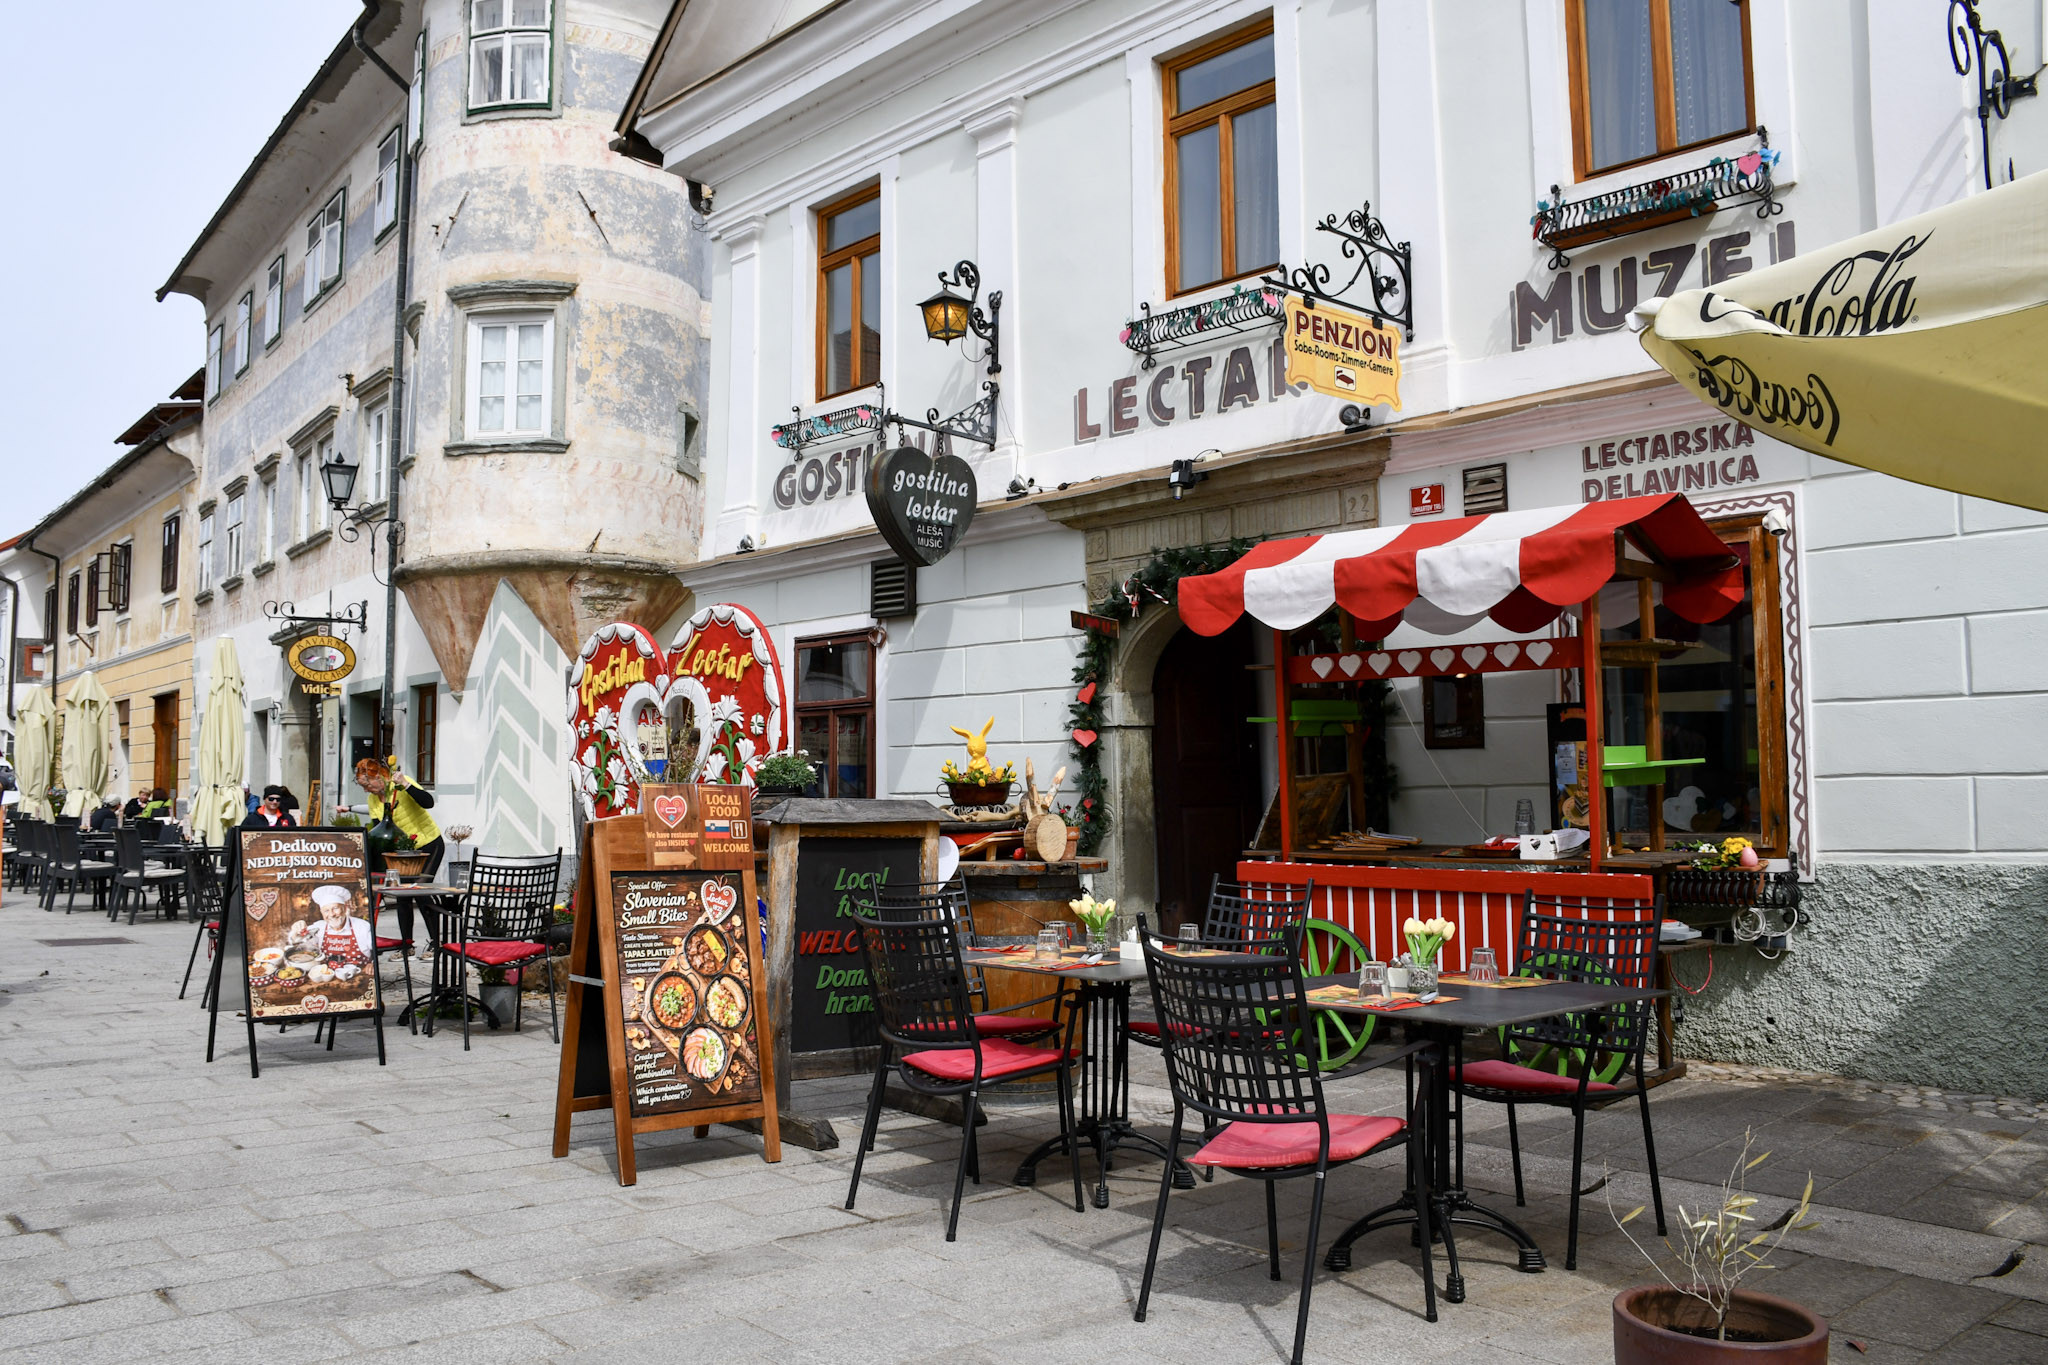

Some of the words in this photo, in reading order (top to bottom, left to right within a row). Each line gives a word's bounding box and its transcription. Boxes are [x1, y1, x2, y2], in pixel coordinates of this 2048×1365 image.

[1294, 310, 1393, 361] PENZION
[1583, 421, 1755, 473] LECTARSKA
[893, 469, 970, 498] gostilna
[1583, 454, 1760, 504] DELAVNICA
[1421, 487, 1432, 505] 2
[905, 495, 959, 525] lectar
[916, 525, 944, 537] ALEŠA
[296, 637, 348, 653] KAVARNA
[675, 632, 754, 682] Lectar
[581, 647, 646, 718] Gostilna
[706, 794, 741, 806] LOCAL
[709, 806, 741, 817] FOOD
[270, 838, 337, 854] Dedkovo
[668, 839, 689, 847] INSIDE
[703, 843, 751, 854] WELCOME
[246, 855, 318, 870] NEDELJSKO
[320, 856, 363, 869] KOSILO
[292, 868, 335, 881] Lectarju
[628, 881, 651, 893] Special
[651, 881, 668, 892] Offer
[623, 892, 688, 912] Slovenian
[620, 909, 658, 929] Small
[658, 907, 689, 925] Bites
[624, 949, 646, 959] TAPAS
[647, 947, 676, 957] PLATTER
[634, 1052, 654, 1062] Create
[634, 1060, 657, 1075] perfect
[635, 1063, 677, 1080] combination!
[636, 1086, 655, 1097] Which
[655, 1082, 689, 1093] combination
[638, 1095, 650, 1105] will
[650, 1095, 662, 1107] you
[661, 1089, 685, 1102] choose?
